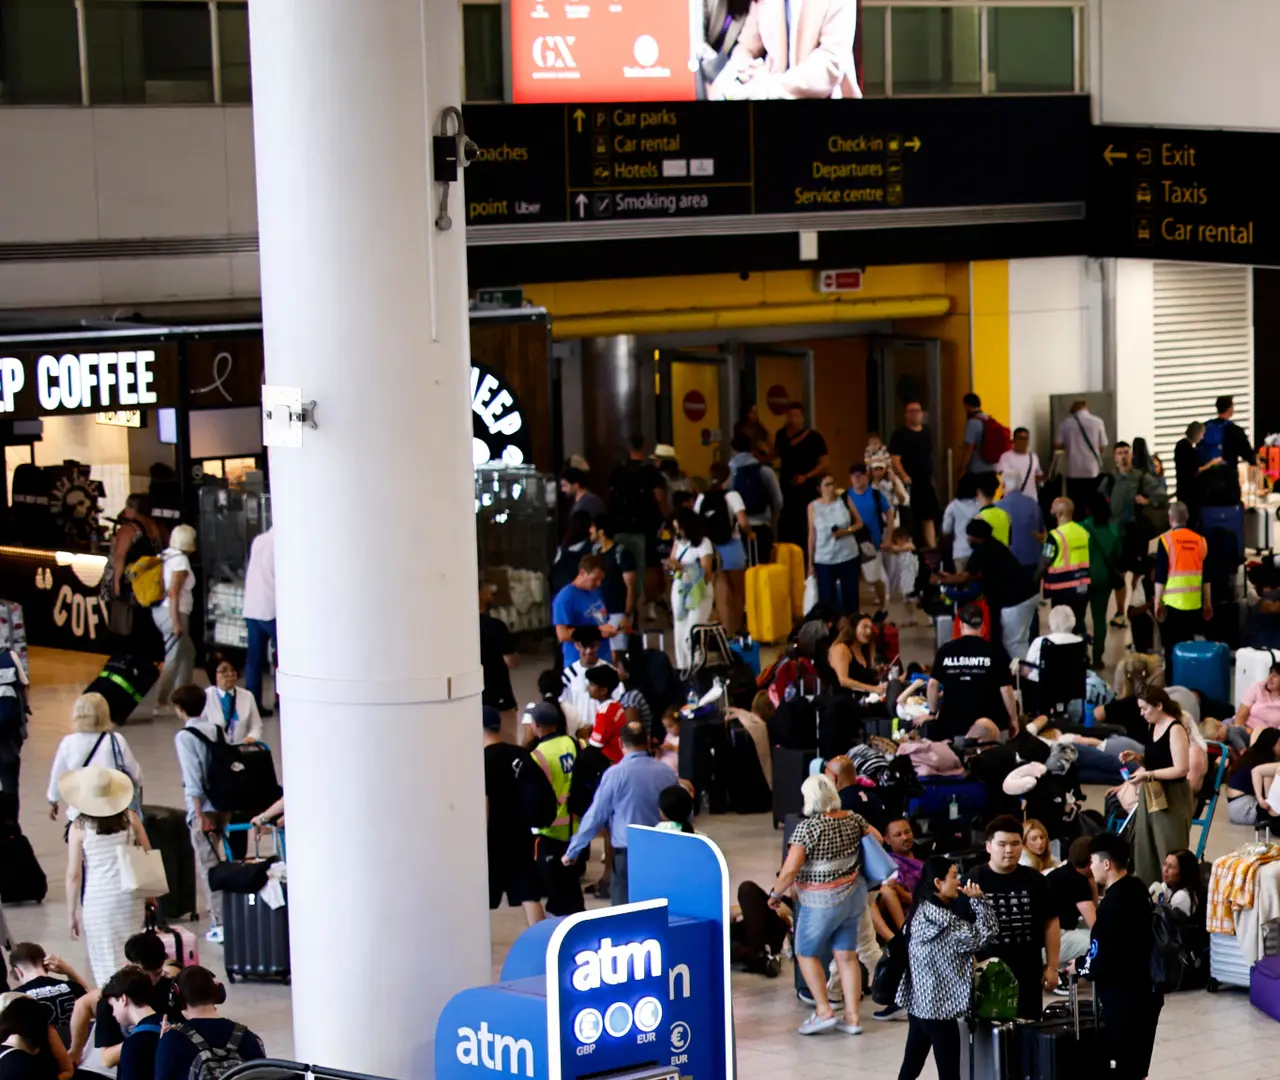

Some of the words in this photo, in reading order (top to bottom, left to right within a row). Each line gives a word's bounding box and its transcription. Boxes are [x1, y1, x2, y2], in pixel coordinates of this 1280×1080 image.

[613, 108, 637, 127] Car
[640, 107, 677, 129] parks
[478, 142, 529, 161] oaches
[614, 135, 637, 153] Car
[641, 134, 680, 152] rental
[828, 134, 883, 153] Check-in
[1161, 142, 1197, 167] Exit
[614, 161, 659, 179] Hotels
[812, 161, 883, 181] Departures
[615, 192, 677, 214] Smoking
[679, 193, 708, 209] area
[793, 186, 840, 205] Service
[843, 186, 884, 202] centre
[1161, 180, 1208, 205] Taxis
[470, 198, 508, 219] point
[514, 200, 541, 214] Uber
[1161, 217, 1193, 241] Car
[1198, 220, 1253, 245] rental
[37, 350, 157, 410] COFFEE
[943, 656, 991, 667] ALLSAINTS
[571, 937, 662, 992] atm
[455, 1021, 534, 1078] atm
[576, 1043, 596, 1056] GBP
[637, 1031, 656, 1045] EUR
[670, 1053, 688, 1065] EUR
